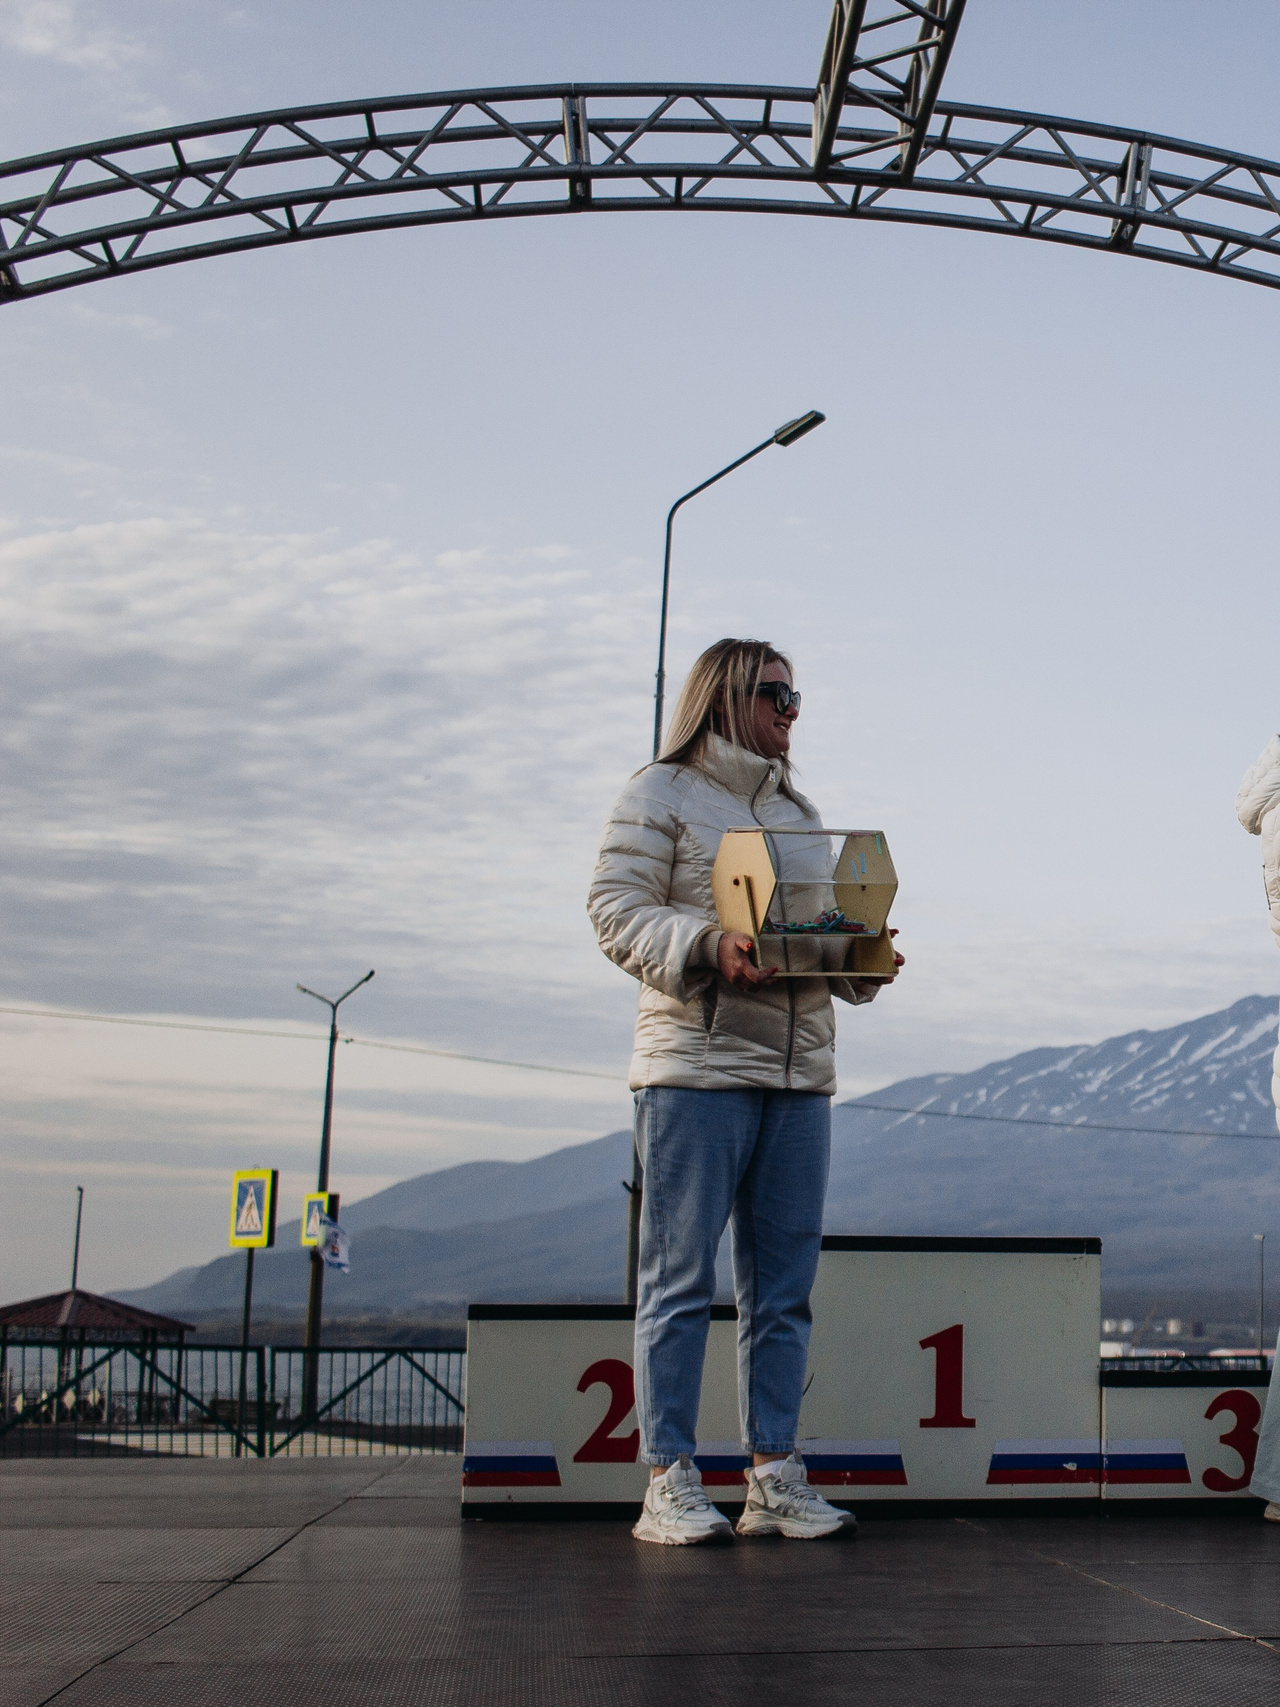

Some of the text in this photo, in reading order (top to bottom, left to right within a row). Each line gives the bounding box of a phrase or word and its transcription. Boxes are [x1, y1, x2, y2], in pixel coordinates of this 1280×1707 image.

[572, 1357, 641, 1463] 2
[918, 1323, 977, 1429] 1
[1202, 1388, 1262, 1493] 3
